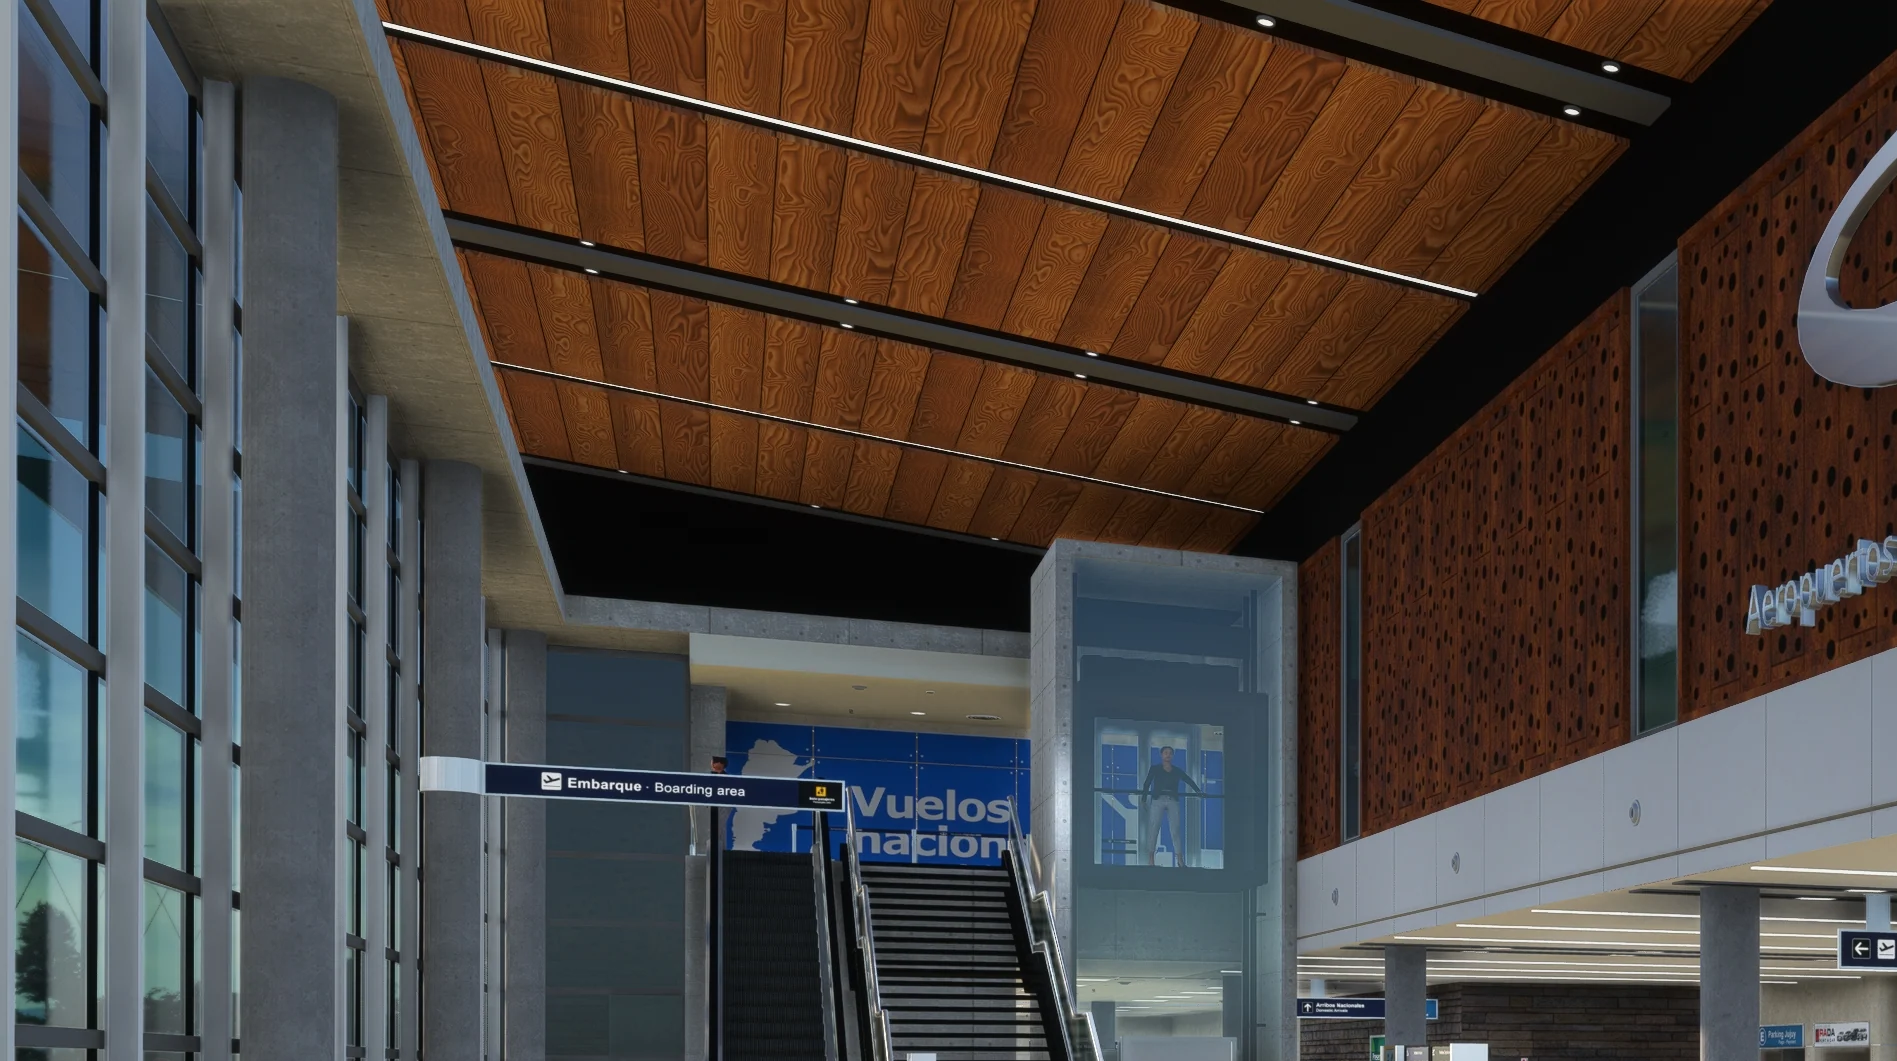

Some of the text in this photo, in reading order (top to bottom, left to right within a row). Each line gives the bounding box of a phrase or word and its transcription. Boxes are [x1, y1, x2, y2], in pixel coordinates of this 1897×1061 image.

[567, 777, 746, 797] Embarque Boarding area
[851, 786, 1009, 823] Vuelos
[855, 825, 1010, 858] nacion
